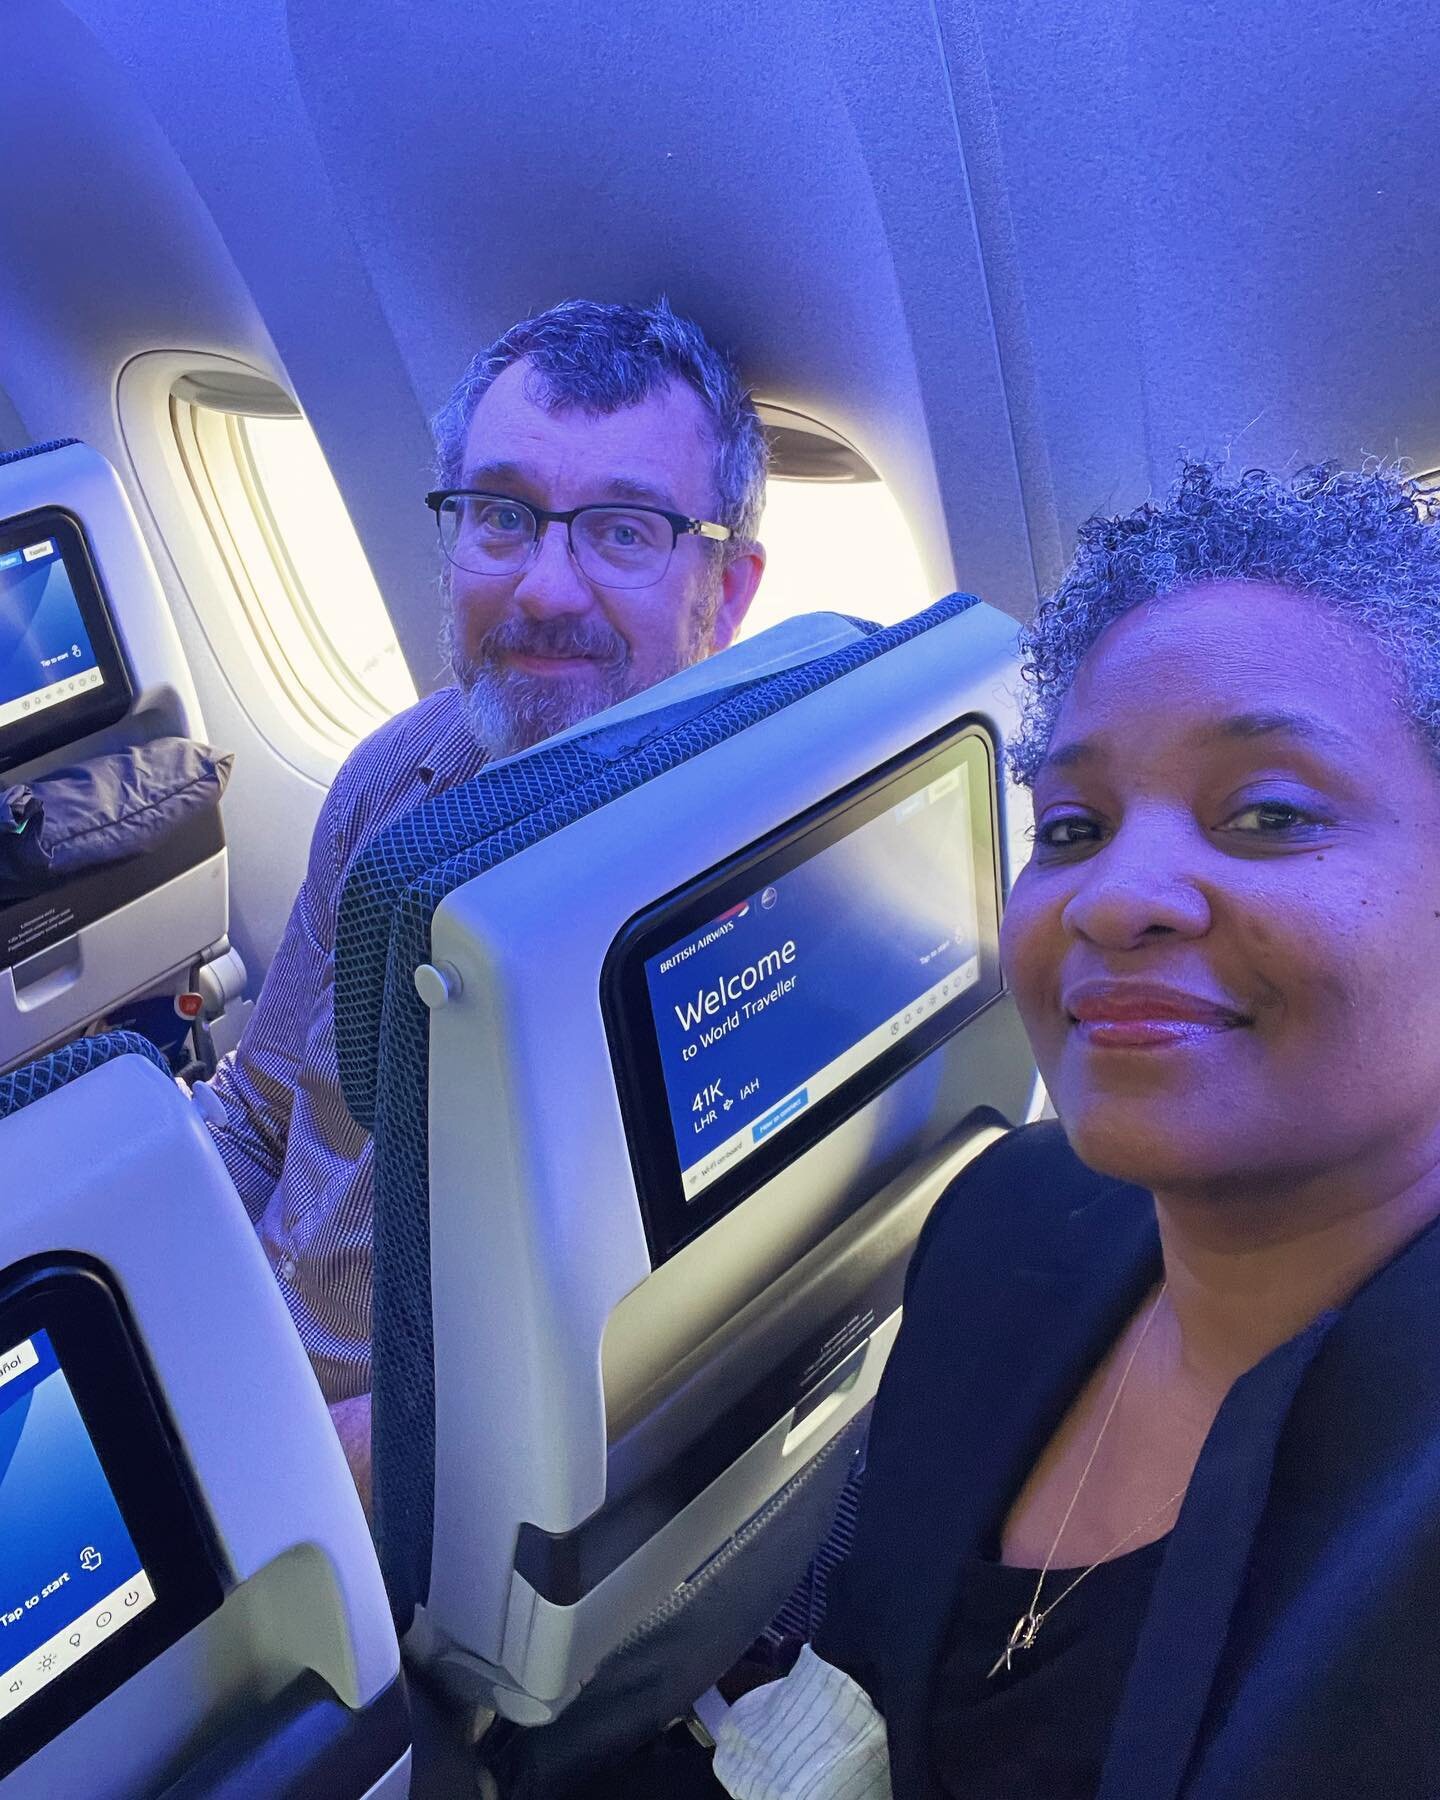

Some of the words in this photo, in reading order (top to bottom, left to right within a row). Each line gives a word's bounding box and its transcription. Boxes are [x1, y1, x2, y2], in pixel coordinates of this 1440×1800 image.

[660, 943, 696, 974] BRITISH
[697, 920, 734, 951] AIRWAYS
[674, 940, 796, 1031] Welcome
[682, 1044, 697, 1061] to
[700, 1011, 740, 1048] World
[741, 975, 797, 1019] Traveller
[692, 1078, 724, 1112] 41K
[694, 1110, 718, 1134] LHR
[740, 1078, 760, 1101] IAH
[0, 1607, 24, 1627] Tap
[24, 1595, 40, 1609] to
[41, 1572, 71, 1598] start
